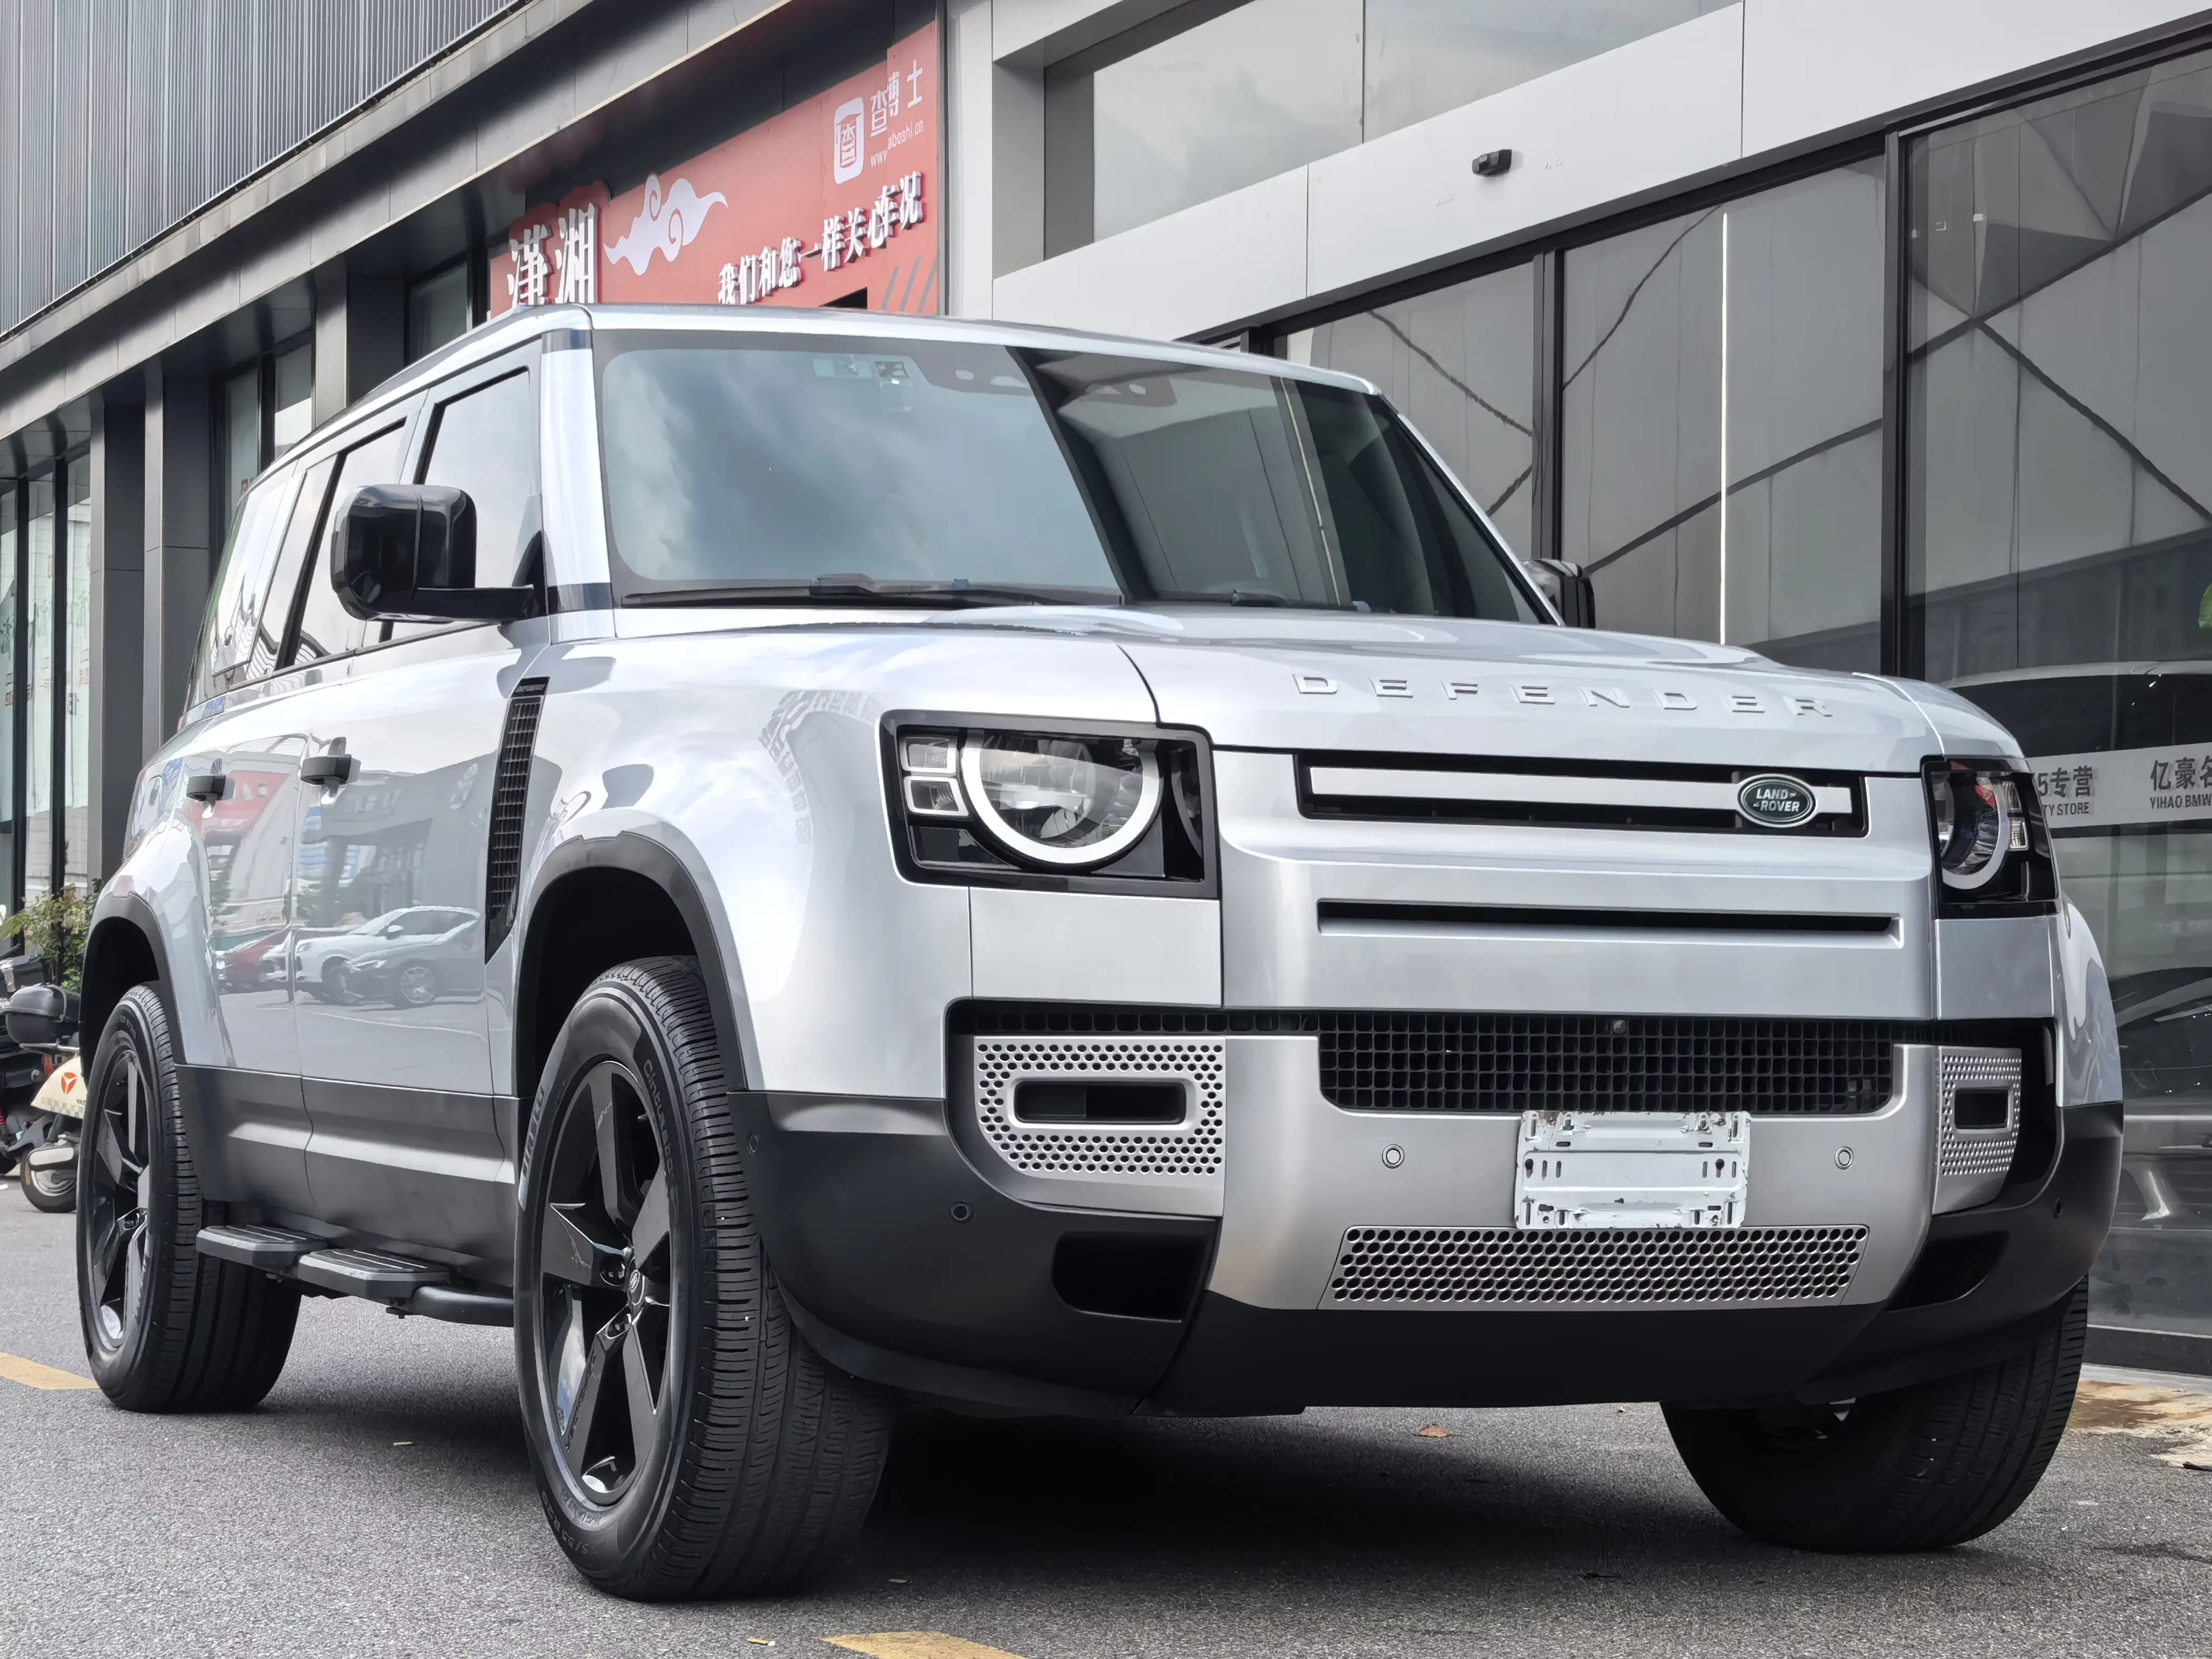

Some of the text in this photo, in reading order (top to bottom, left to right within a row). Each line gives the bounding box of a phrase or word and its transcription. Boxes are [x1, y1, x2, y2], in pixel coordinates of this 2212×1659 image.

[871, 59, 923, 137] 查博士
[718, 171, 923, 306] 我们和您一样关心车况
[1292, 672, 1835, 718] DEFENDER
[1756, 788, 1789, 799] LAND
[2149, 793, 2212, 810] YIHAO BMW
[1760, 800, 1800, 812] ROVER
[2056, 801, 2090, 816] STORE
